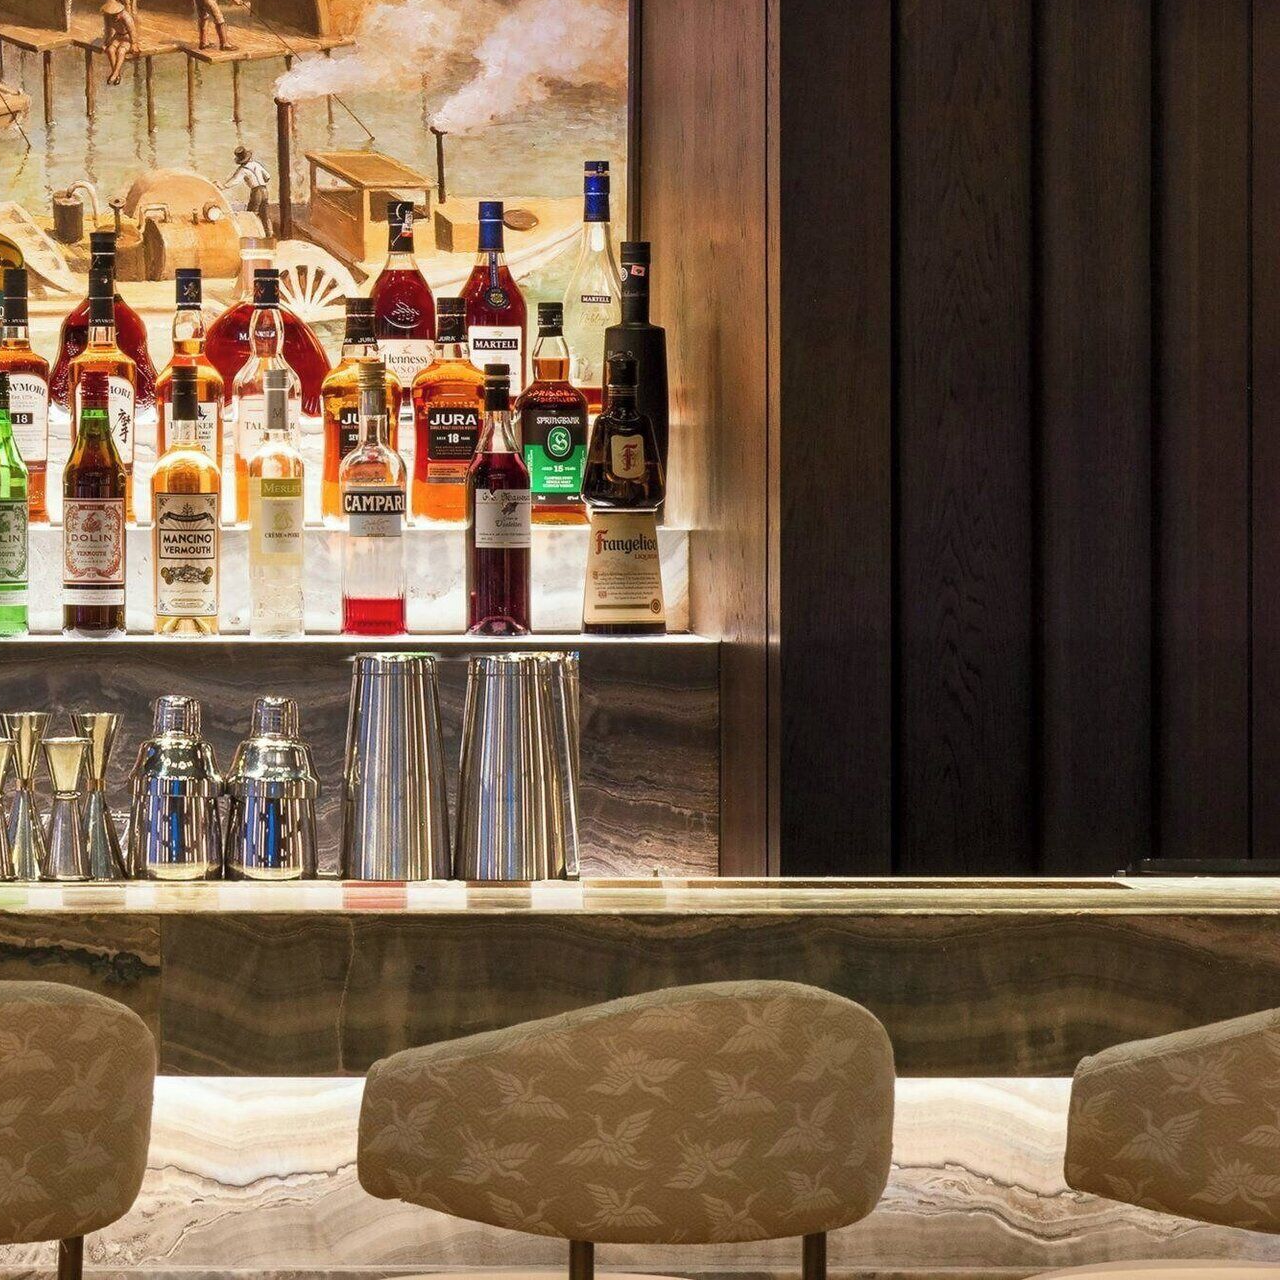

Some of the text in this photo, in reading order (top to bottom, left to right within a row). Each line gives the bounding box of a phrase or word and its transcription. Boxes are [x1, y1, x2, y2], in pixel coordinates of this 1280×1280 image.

[16, 415, 28, 423] 18
[342, 414, 359, 425] JU
[430, 414, 477, 425] JURA
[448, 434, 459, 443] 18
[344, 495, 406, 512] CAMPARI
[71, 534, 112, 542] DOLIN
[163, 534, 212, 543] MANCINO
[595, 530, 656, 555] Frangelico
[164, 546, 211, 554] VERMOUTH
